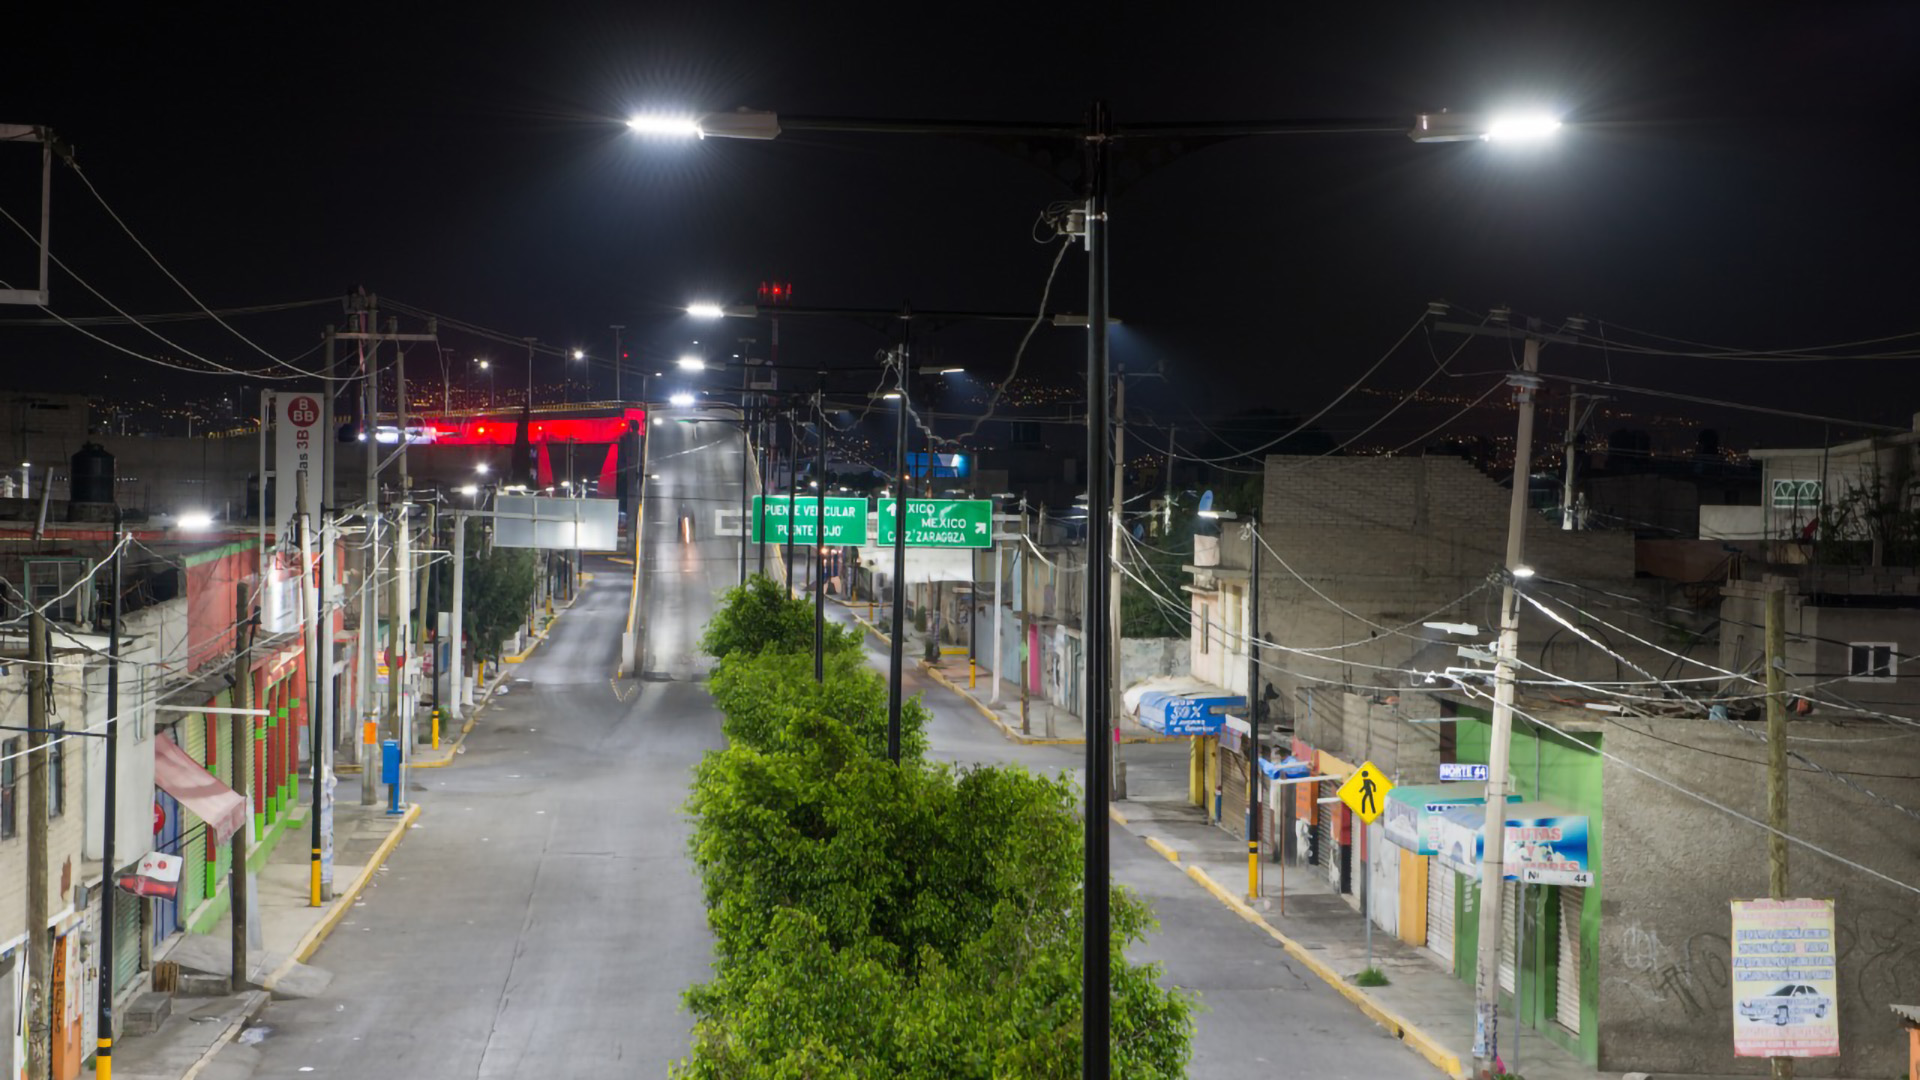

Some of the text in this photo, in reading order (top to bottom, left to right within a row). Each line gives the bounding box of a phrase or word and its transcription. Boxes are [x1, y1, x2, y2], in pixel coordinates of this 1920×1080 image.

[300, 400, 308, 410] B
[297, 430, 309, 449] 3B
[764, 504, 856, 517] PUENE VECULAR
[921, 518, 966, 529] MEXICO
[1473, 766, 1488, 780] 44
[1573, 874, 1588, 883] 44
